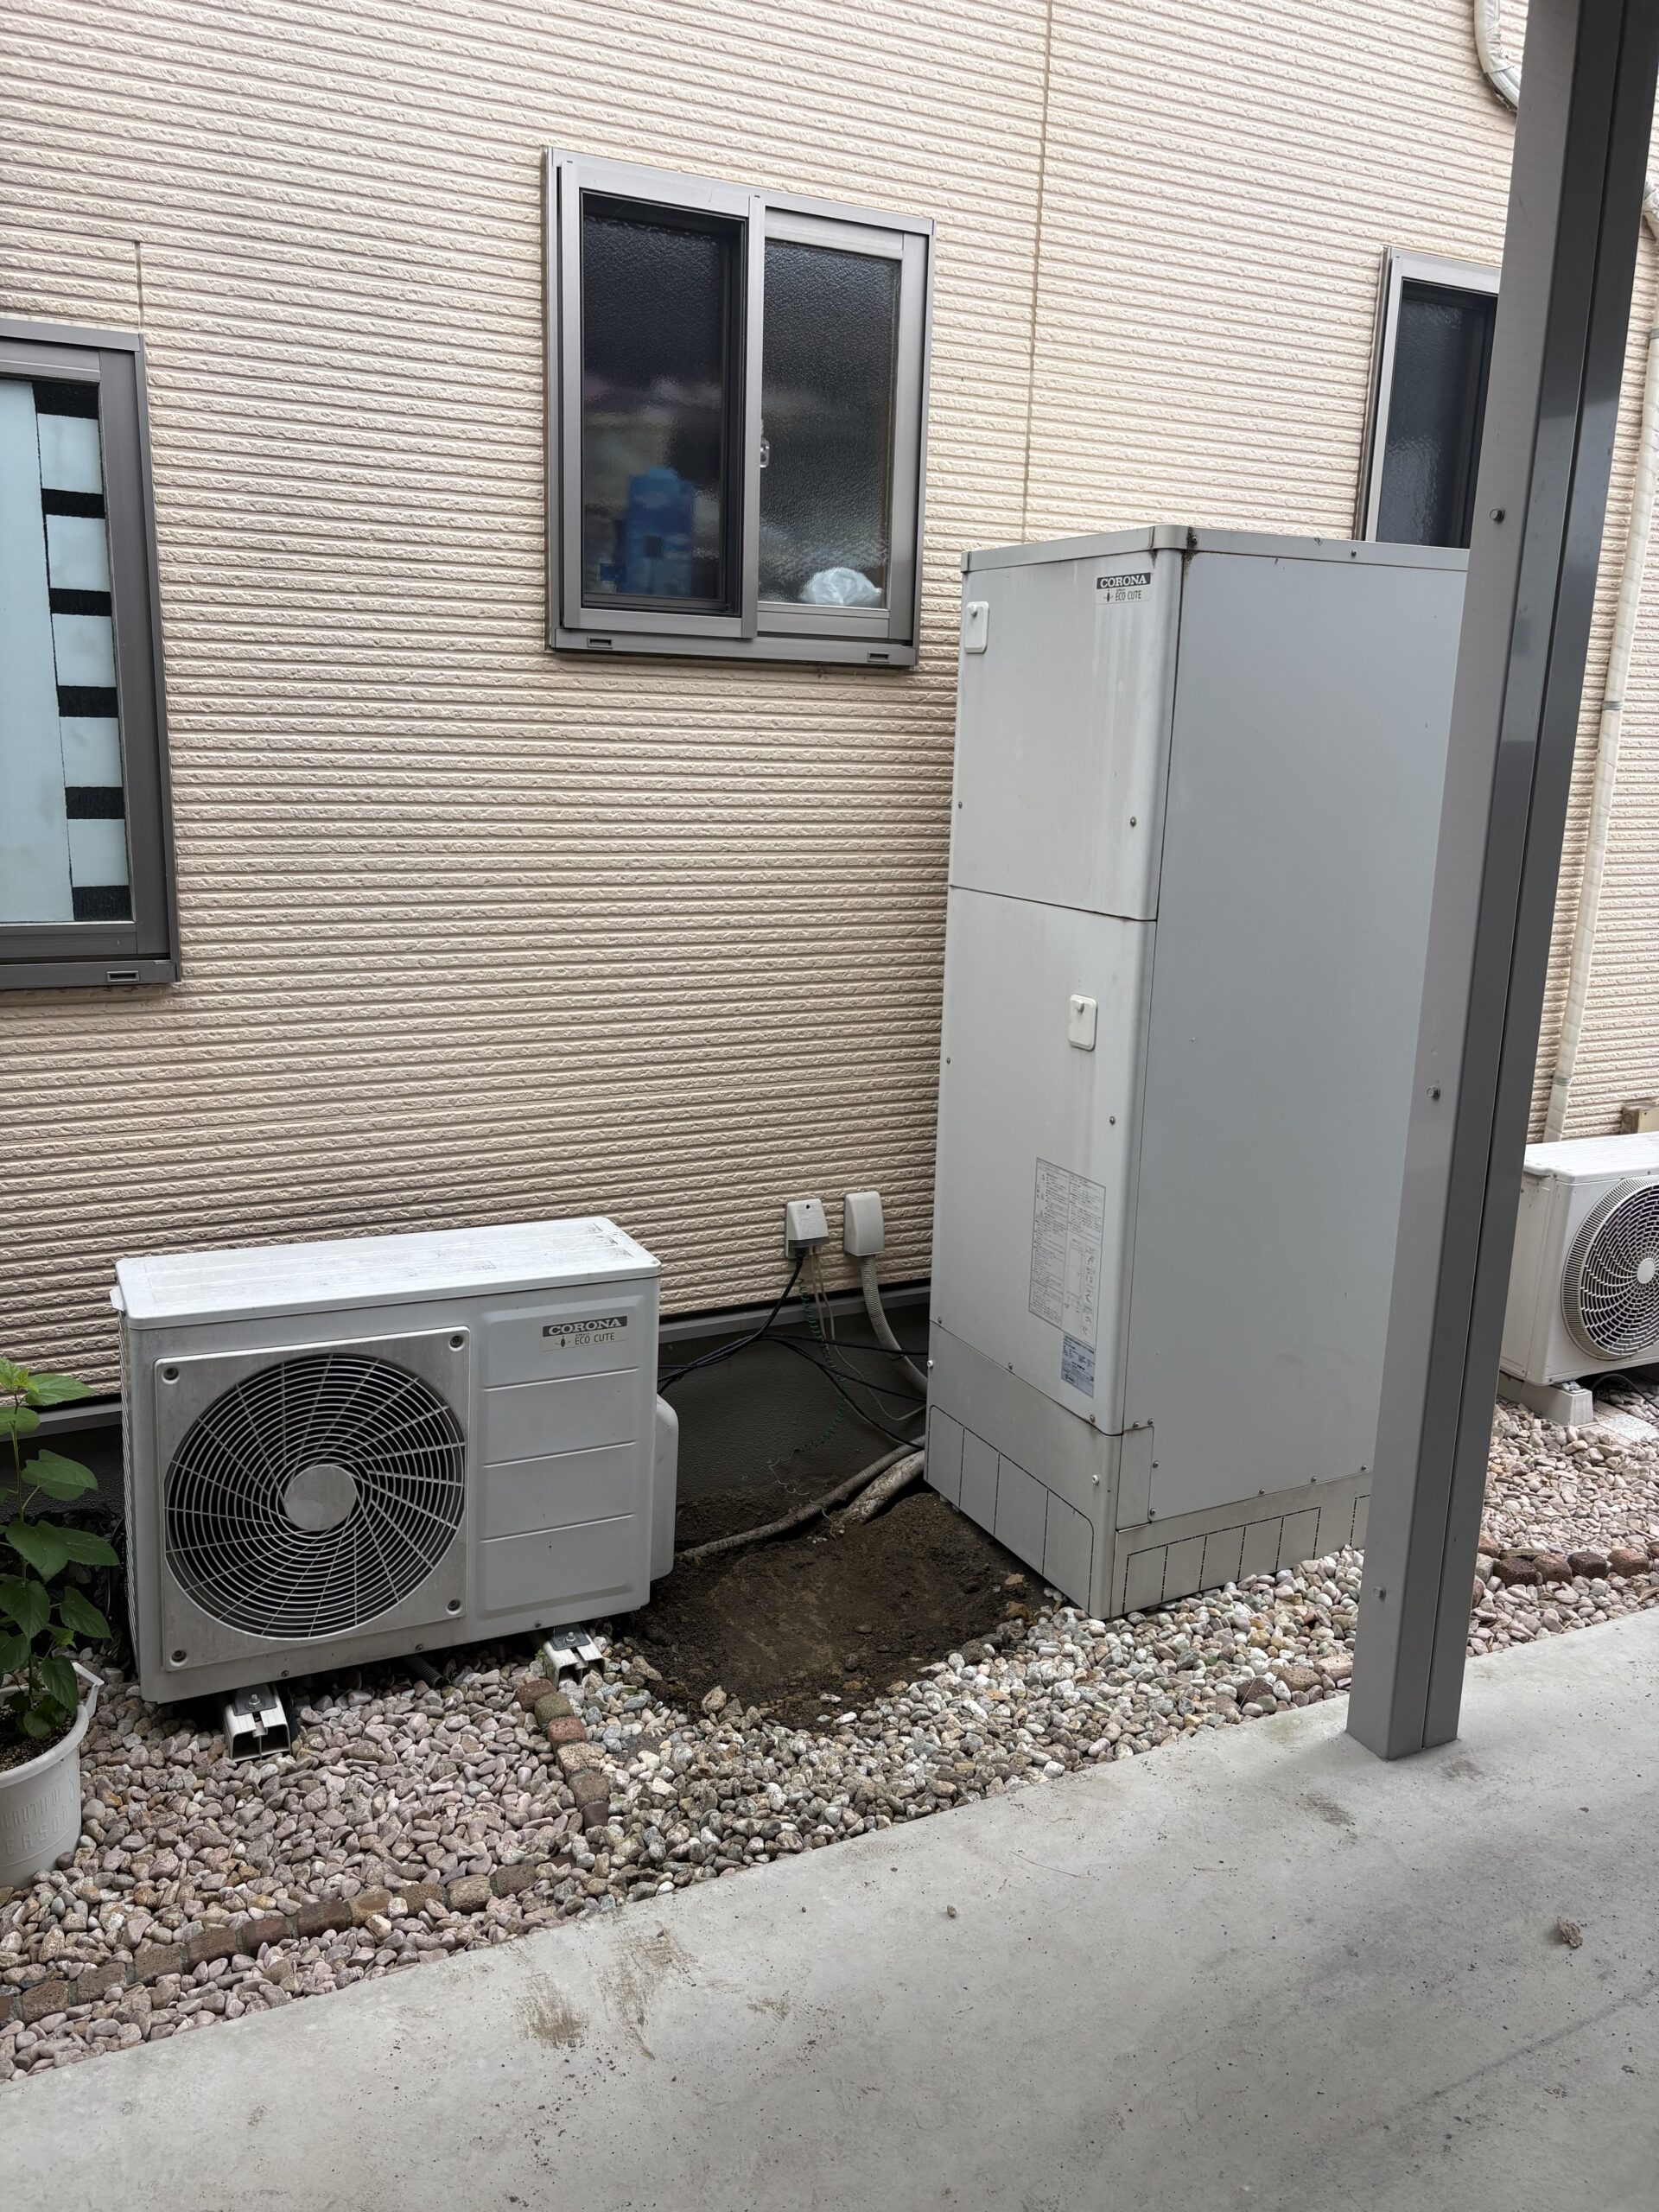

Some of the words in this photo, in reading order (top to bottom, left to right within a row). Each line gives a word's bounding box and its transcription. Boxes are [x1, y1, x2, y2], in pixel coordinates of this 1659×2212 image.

[1100, 575, 1147, 588] CORONA
[1115, 591, 1126, 601] ECO
[1127, 590, 1142, 601] CUTE
[548, 1318, 622, 1336] CORONA
[575, 1335, 591, 1345] ECO
[594, 1332, 615, 1343] CUTE
